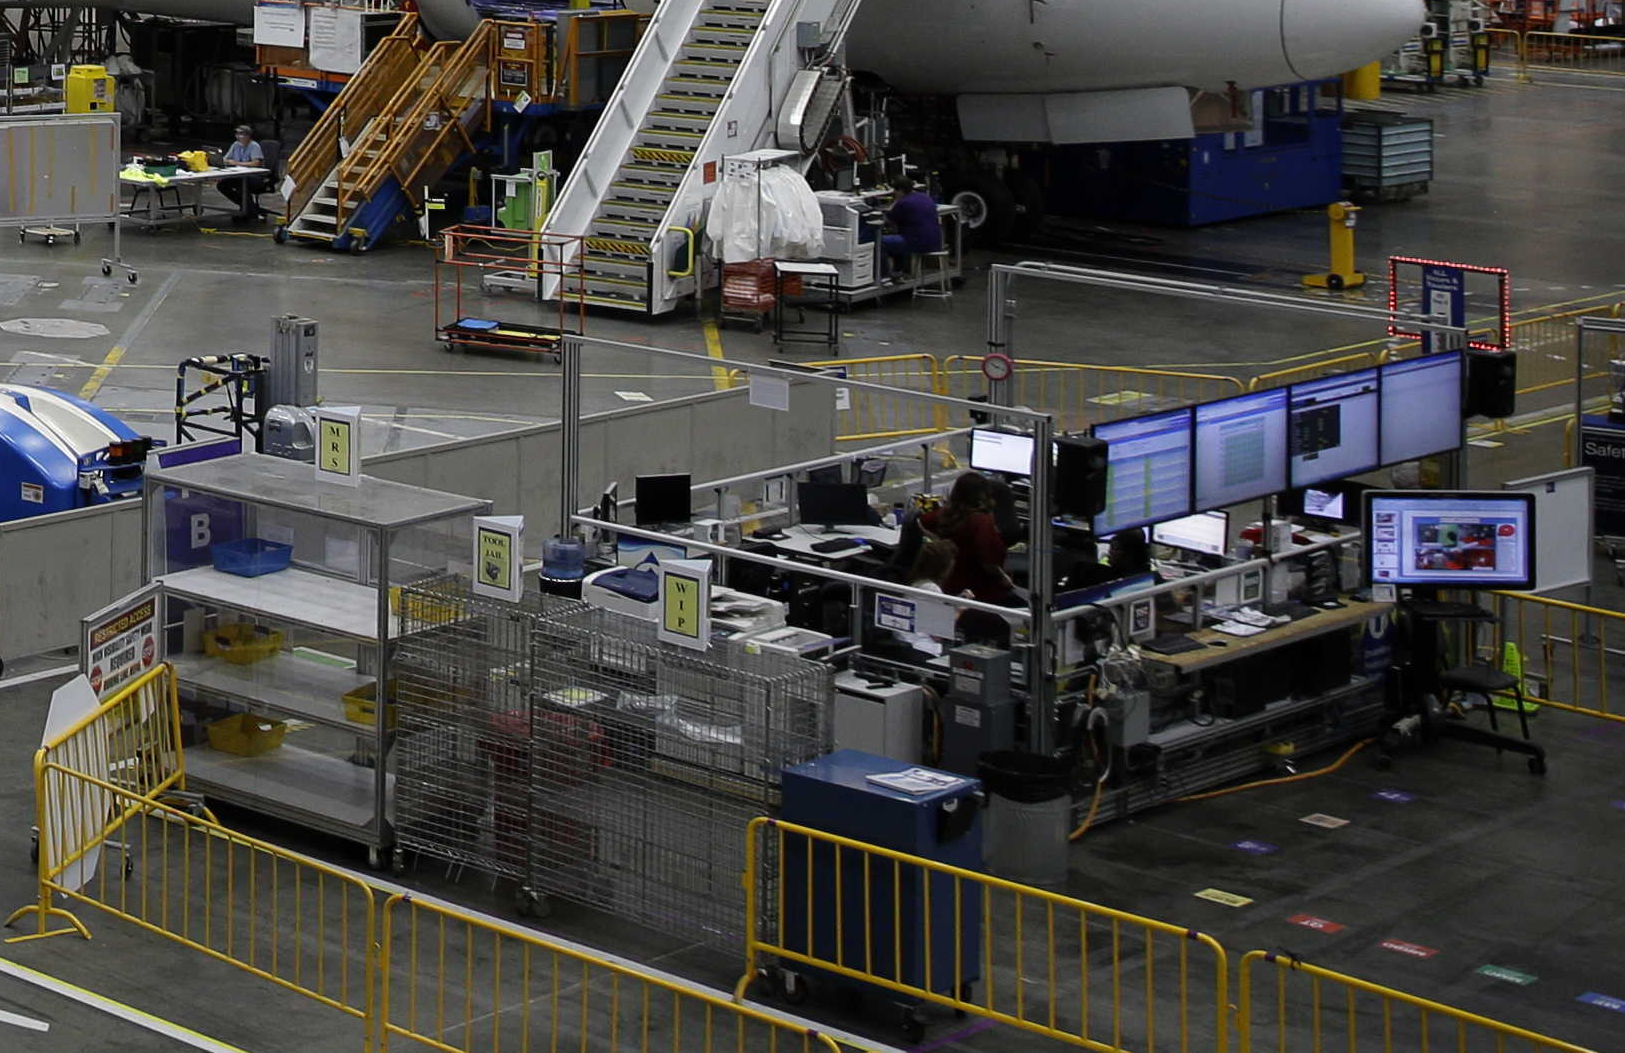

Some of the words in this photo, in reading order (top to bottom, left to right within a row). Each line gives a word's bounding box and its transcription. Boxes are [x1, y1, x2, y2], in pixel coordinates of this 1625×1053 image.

[190, 513, 212, 549] B
[483, 535, 506, 547] TOOL
[484, 549, 504, 560] JAIL
[94, 616, 129, 644] RESTRICTED
[129, 604, 152, 625] ACCESS
[110, 646, 135, 672] REQUIRED
